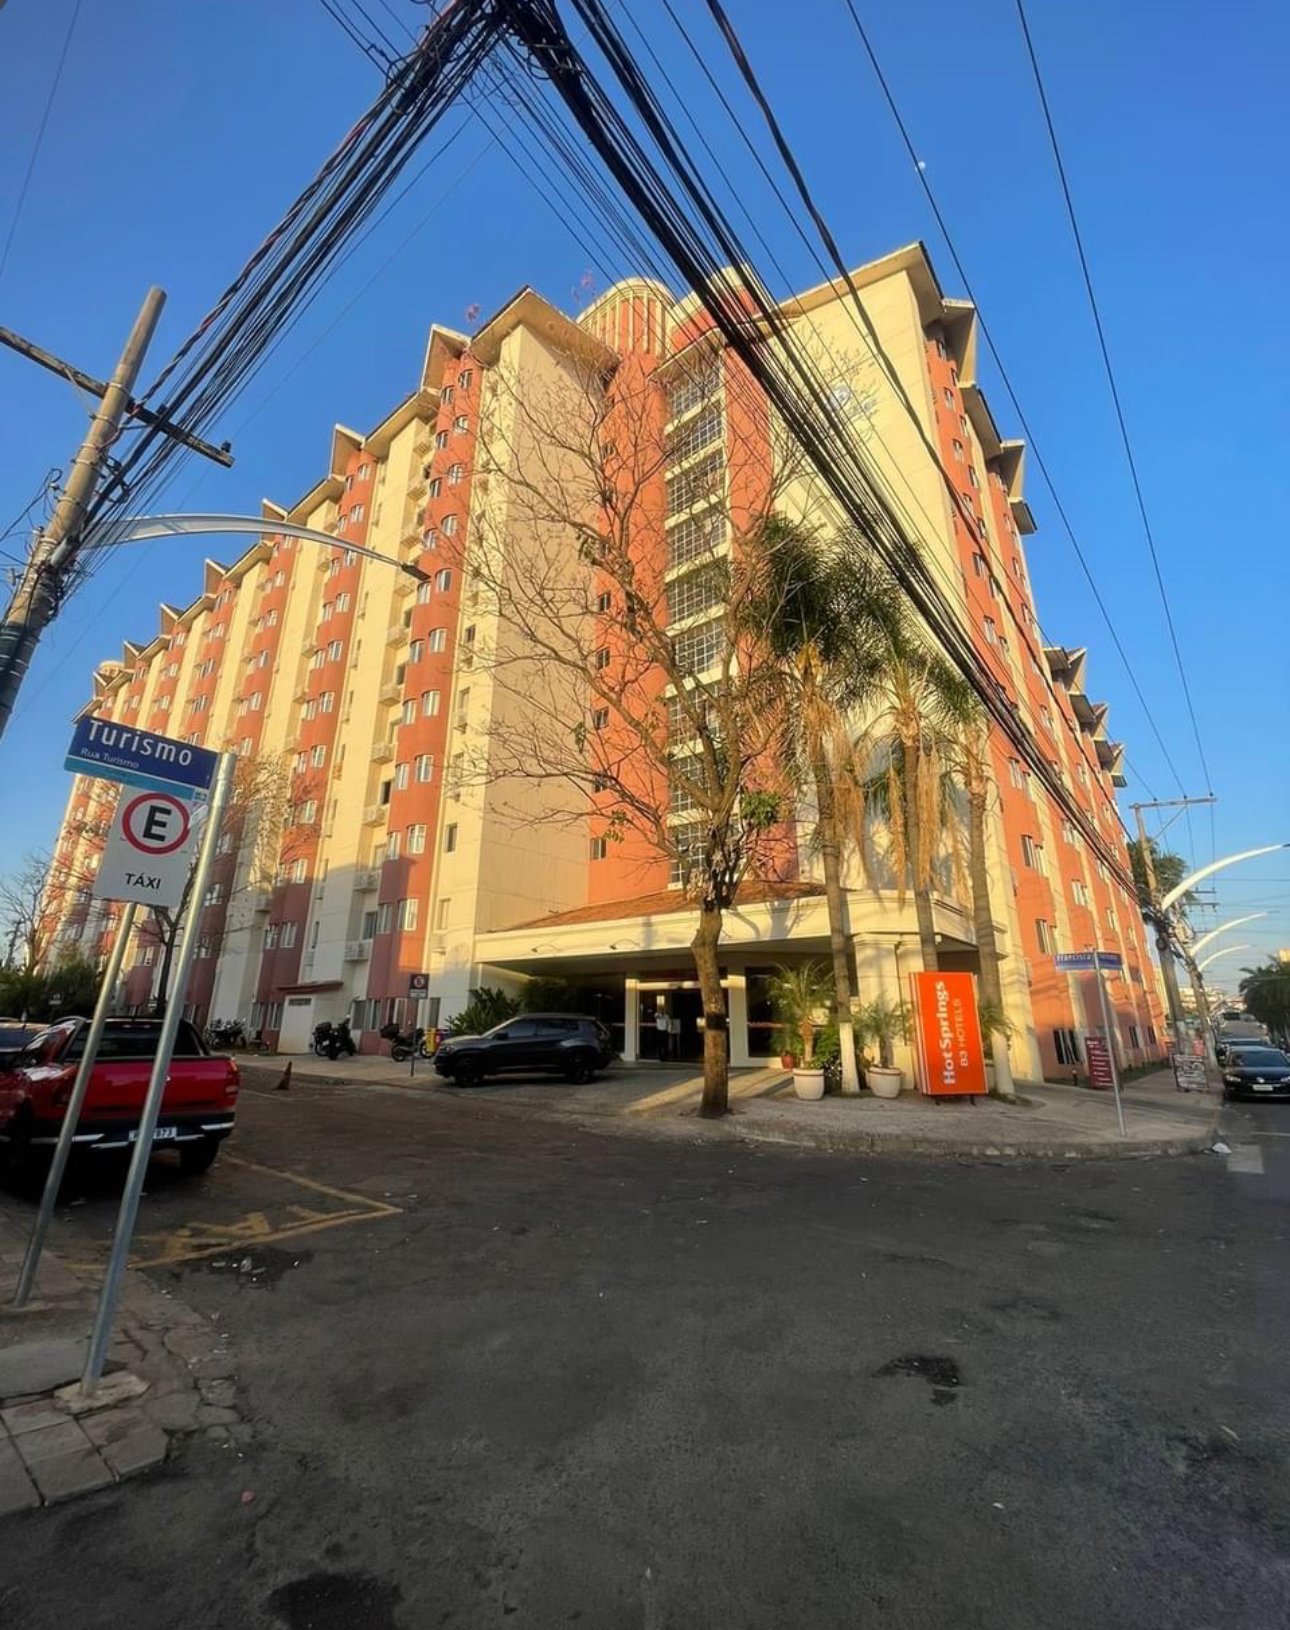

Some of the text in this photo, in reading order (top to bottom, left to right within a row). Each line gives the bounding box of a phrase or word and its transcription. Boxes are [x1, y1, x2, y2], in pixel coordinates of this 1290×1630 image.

[80, 747, 140, 769] Rua Turismo
[88, 719, 193, 767] Turismo
[142, 804, 173, 842] E
[124, 872, 162, 890] TÁXI
[935, 980, 953, 1049] Springs
[953, 998, 967, 1047] HOTELS
